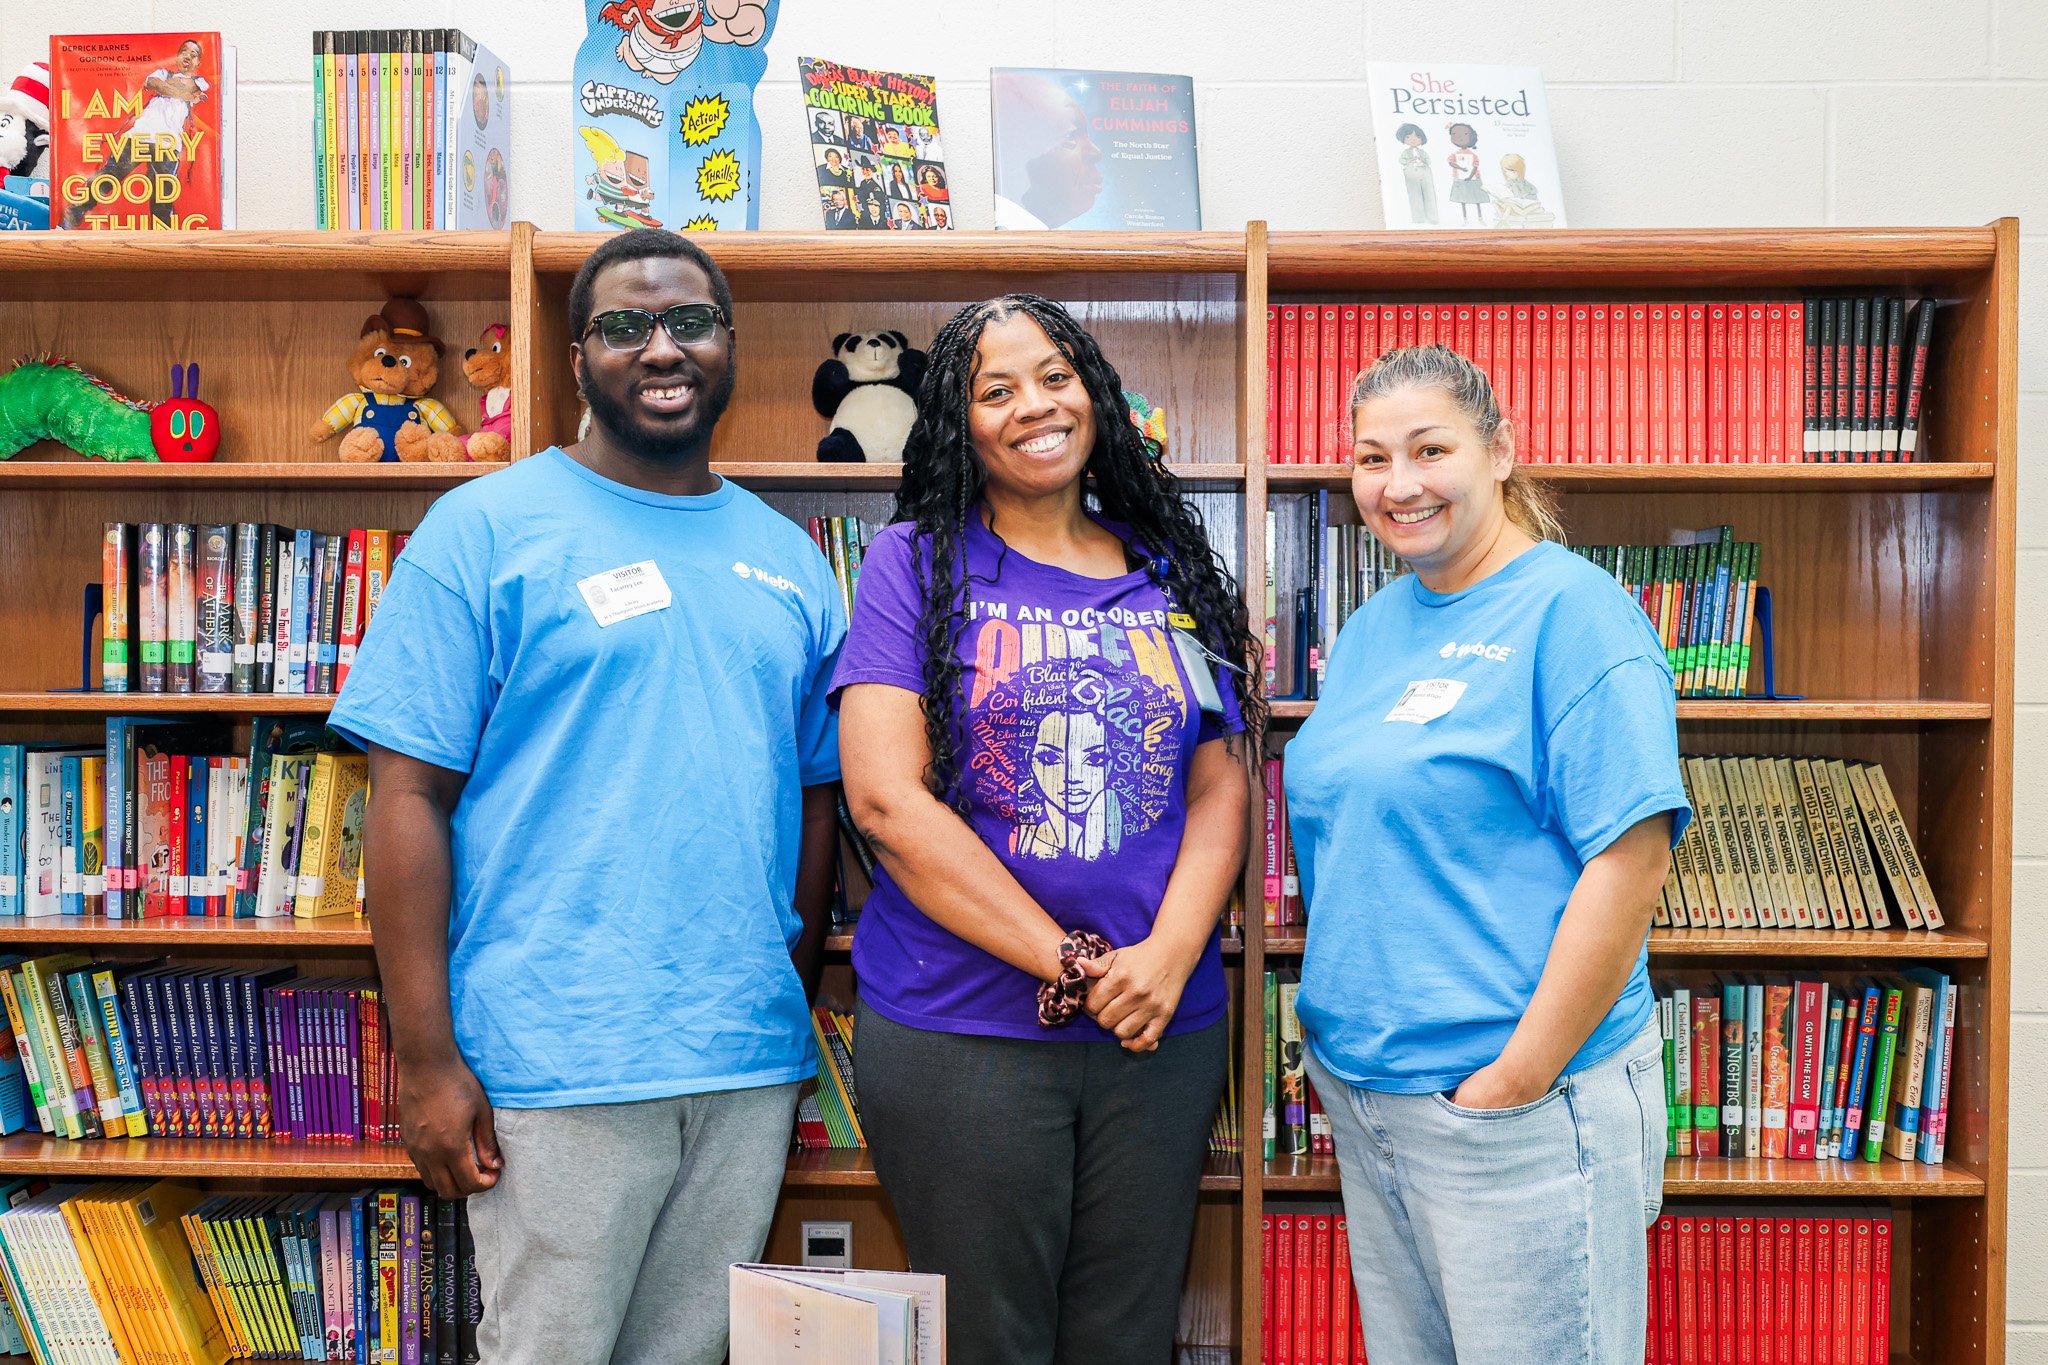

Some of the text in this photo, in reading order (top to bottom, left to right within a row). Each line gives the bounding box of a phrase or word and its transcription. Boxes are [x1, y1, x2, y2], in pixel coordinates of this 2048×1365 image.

[316, 69, 320, 78] 1
[338, 68, 343, 77] 3
[349, 68, 354, 77] 4
[361, 67, 366, 76] 5
[372, 67, 377, 76] 6
[383, 67, 387, 76] 7
[394, 67, 398, 76] 8
[404, 67, 409, 76] 9
[414, 67, 422, 76] 10
[425, 69, 433, 77] 11
[435, 66, 443, 75] 12
[1411, 72, 1456, 93] She
[830, 81, 915, 108] SUPER STARS
[847, 67, 882, 86] BLACK
[888, 76, 936, 105] HISTORY
[1100, 81, 1177, 94] THE FAITH OF
[62, 88, 144, 119] I AM
[580, 98, 664, 128] UNDERPANTS
[809, 88, 936, 126] COLORING BOOK
[1109, 97, 1169, 112] ELIJAH
[1390, 88, 1531, 117] Persisted
[1091, 117, 1190, 133] CUMMINGS
[82, 132, 204, 162] EVERY
[1121, 153, 1143, 161] Equal
[1145, 153, 1173, 161] Justice
[62, 173, 181, 204] GOOD
[613, 567, 642, 579] VISITOR
[202, 576, 216, 647] OF ATHENA
[296, 578, 308, 626] LOOK BOTH
[969, 601, 1167, 630] I'M AN OCTOBER
[219, 601, 231, 644] MARK
[277, 608, 289, 640] The Fourth
[1027, 662, 1080, 684] Black
[973, 720, 1017, 775] Melanin
[1111, 739, 1137, 753] Black
[145, 761, 169, 781] THE
[108, 785, 118, 842] WHITE BIRD
[1266, 799, 1276, 875] KATIE CATSITTER
[1803, 786, 1835, 878] GHOST MACHINE
[1867, 808, 1901, 877] THE CROSSBONES
[261, 828, 272, 877] MONSTER!
[244, 983, 253, 1013] BAREFOOT
[48, 980, 76, 1063] SMITH BLACK PANTHER
[103, 1000, 127, 1066] QUINN PAWS
[247, 1014, 255, 1037] DREAMS
[33, 990, 67, 1099] COLLECTION FUN with FRIENDS
[1912, 1039, 1924, 1069] Before
[1803, 1021, 1814, 1099] GO WITH THE FLOW
[1940, 1035, 1951, 1099] DIGESTIVE SYSTEM
[420, 1250, 434, 1292] LIARS
[327, 1282, 335, 1317] NOCTIS
[444, 1254, 454, 1323] CATWOMAN
